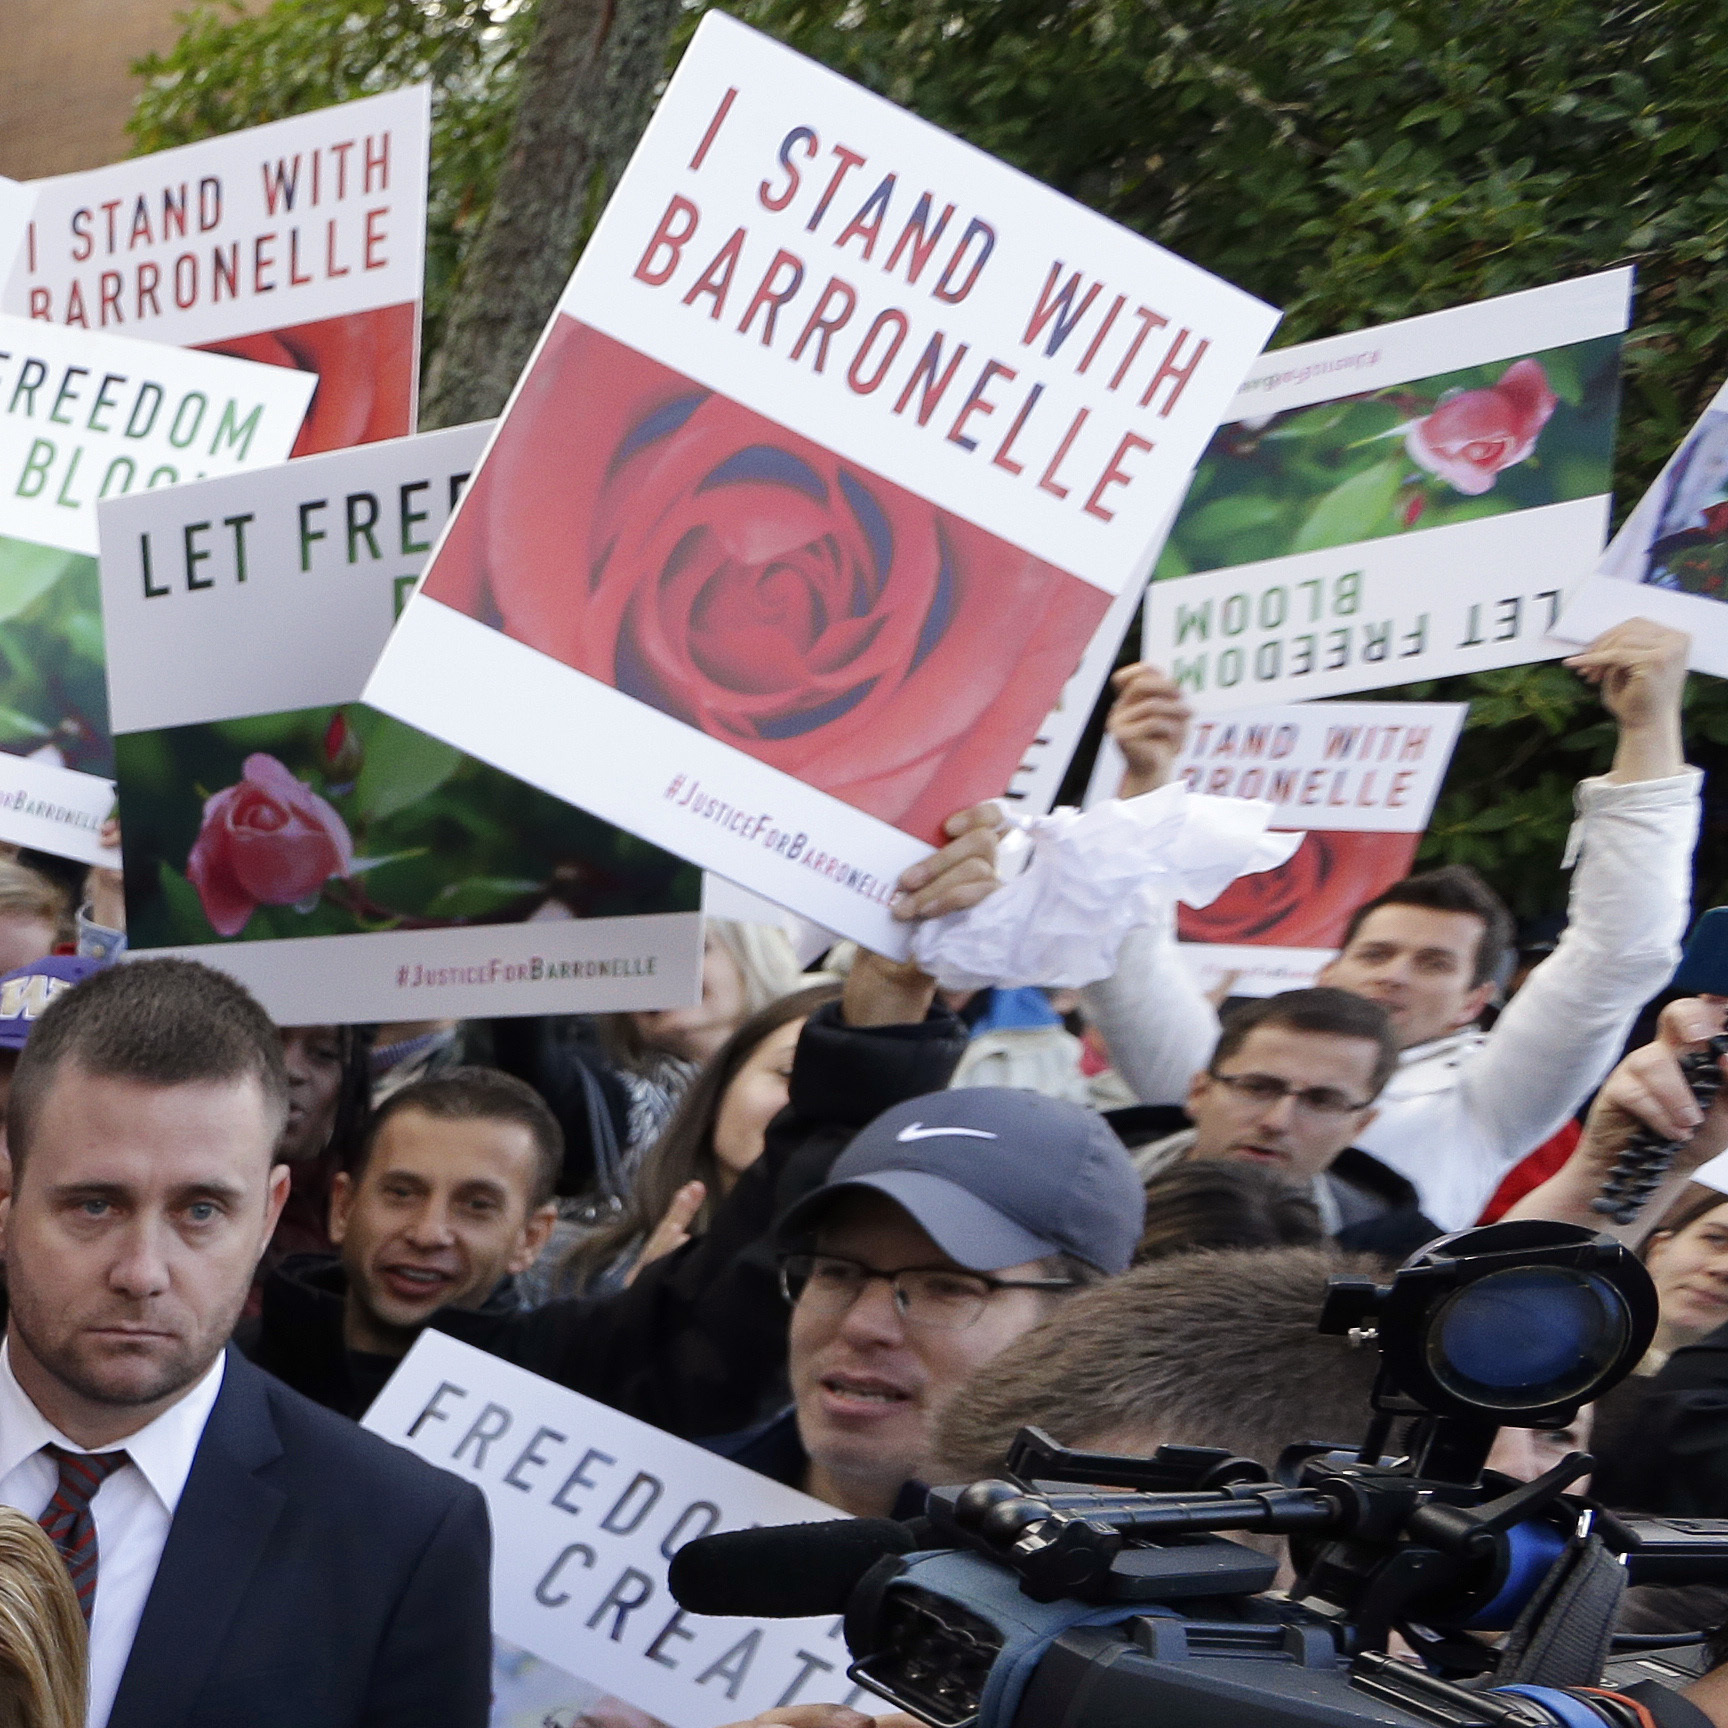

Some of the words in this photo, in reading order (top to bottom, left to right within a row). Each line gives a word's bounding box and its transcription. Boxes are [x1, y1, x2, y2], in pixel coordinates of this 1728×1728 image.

[28, 221, 37, 273] I
[72, 176, 224, 262] STAND
[261, 131, 392, 217] WITH
[29, 206, 392, 330] BARRONELLE
[689, 87, 737, 171] I
[758, 125, 997, 305] STAND
[1021, 259, 1211, 419] WITH
[633, 193, 1157, 523] BARRONELLE
[141, 511, 255, 599] LET
[1173, 569, 1366, 647] BLOOM
[1456, 588, 1563, 650] LET
[1322, 724, 1435, 762] WITH
[406, 1378, 761, 1563] FREEDO
[535, 1542, 864, 1709] CREAT
